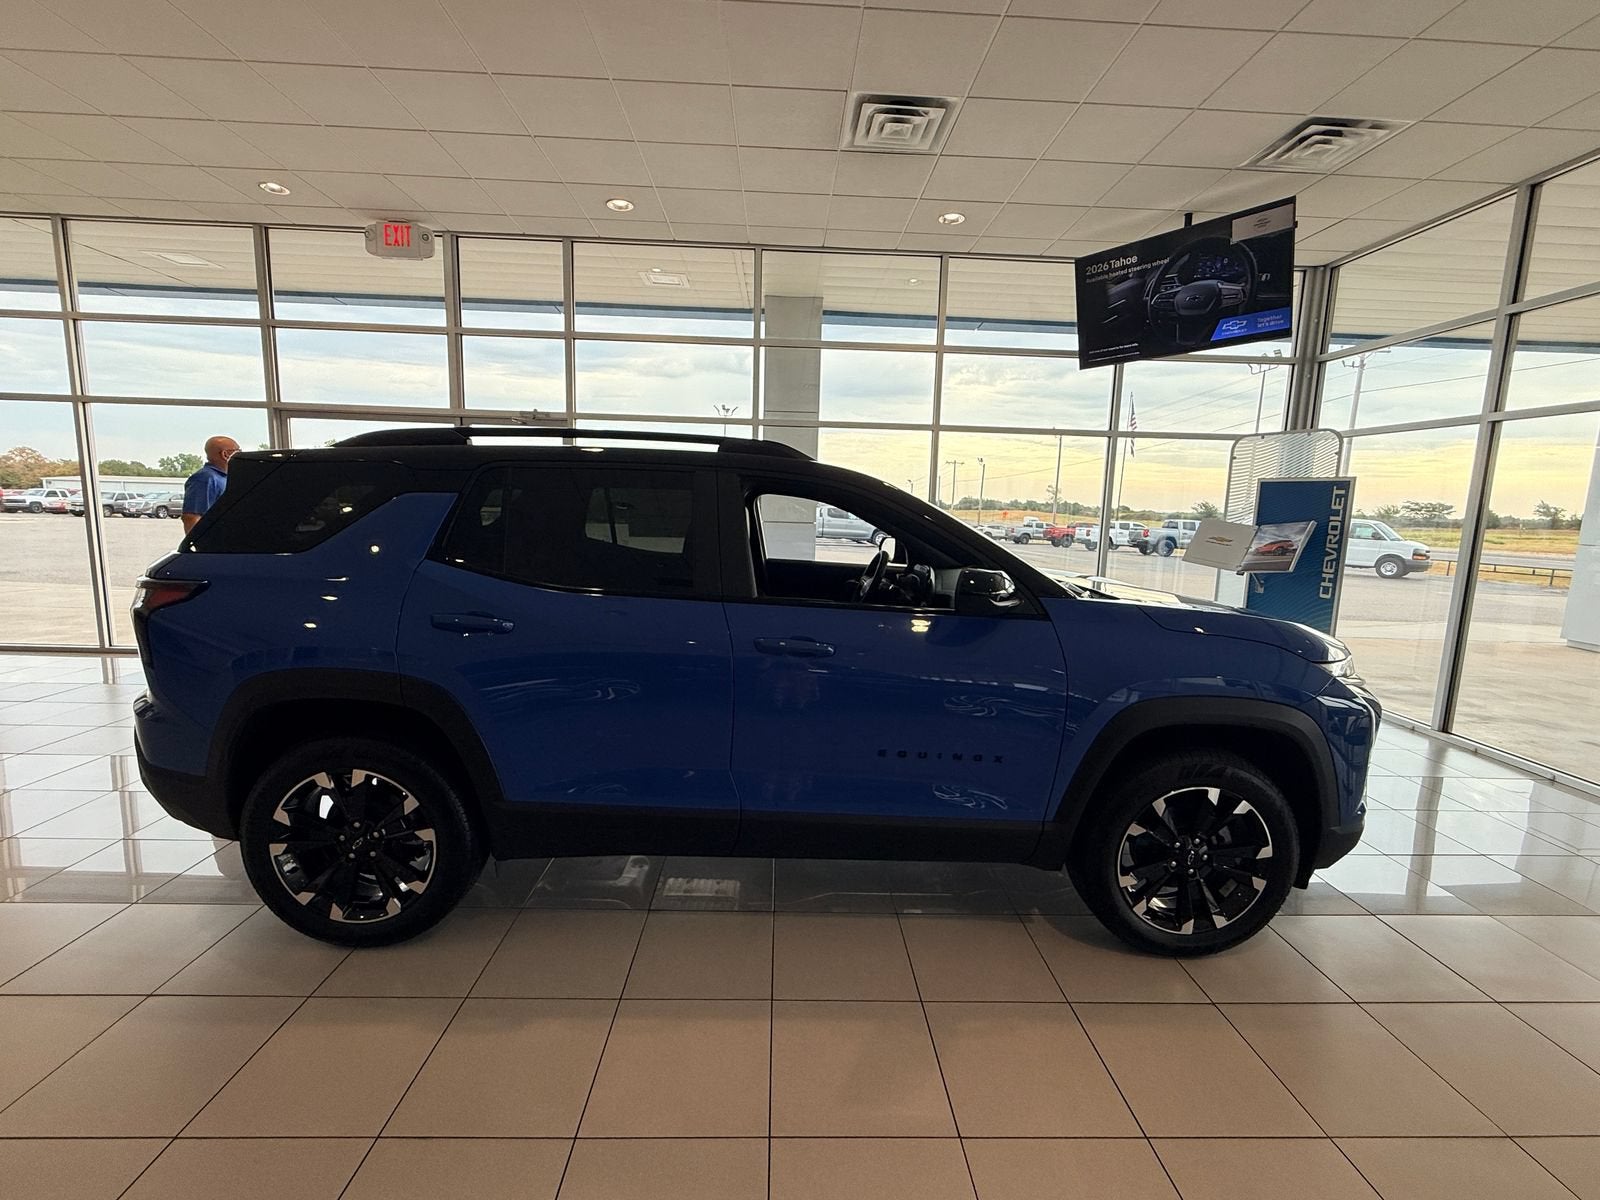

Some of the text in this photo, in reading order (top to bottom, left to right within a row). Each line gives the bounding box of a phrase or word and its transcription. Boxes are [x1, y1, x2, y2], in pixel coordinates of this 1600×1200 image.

[384, 224, 411, 247] EXIT
[1086, 255, 1138, 275] 2026 Tahoe
[1109, 268, 1128, 278] heated
[1128, 263, 1151, 273] steering
[1152, 257, 1170, 266] wheel
[1319, 486, 1346, 600] CHEVROLET
[877, 749, 1004, 764] EQUINOX
